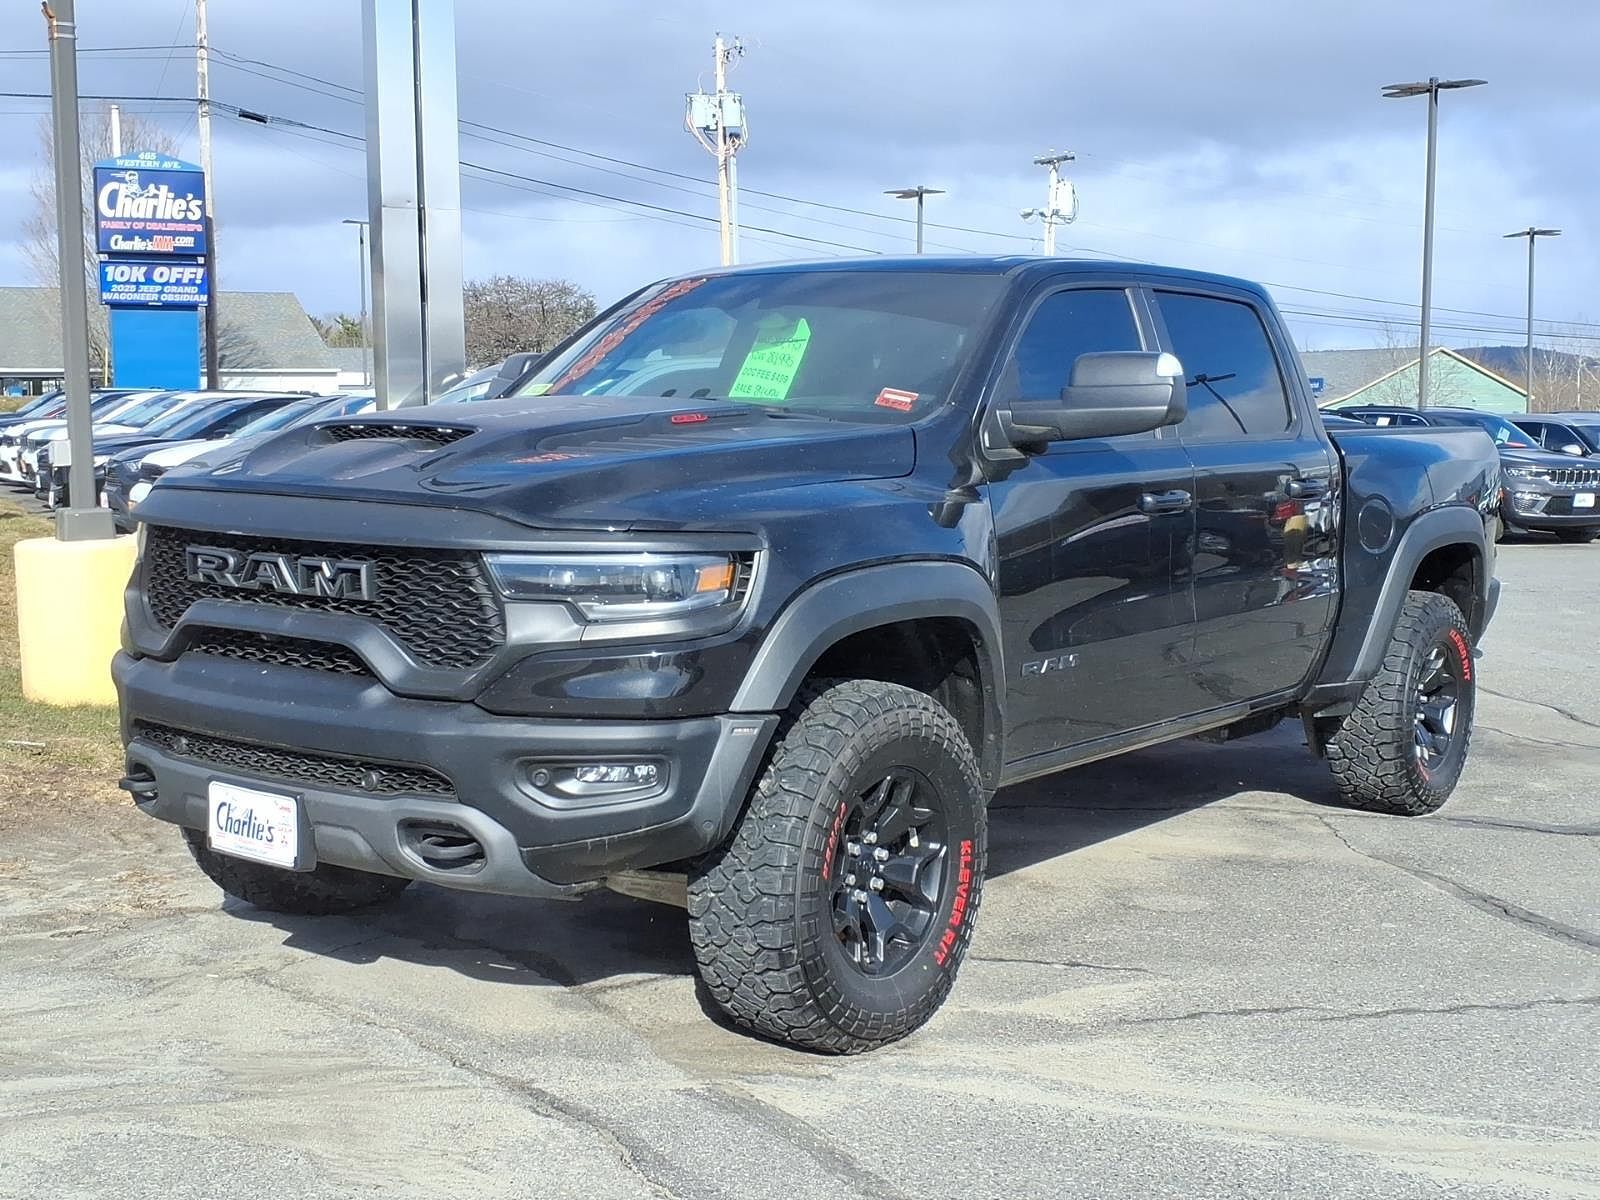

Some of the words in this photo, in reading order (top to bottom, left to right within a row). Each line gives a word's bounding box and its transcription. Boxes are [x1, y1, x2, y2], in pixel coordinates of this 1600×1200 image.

[116, 159, 160, 168] WESTERN
[98, 182, 203, 221] Charlie's
[101, 221, 130, 230] FAMILY
[132, 221, 145, 230] OF
[104, 265, 148, 283] 10K
[152, 266, 205, 284] OFF!
[110, 284, 137, 293] 2025
[138, 285, 163, 293] JEEP
[163, 285, 199, 294] GRAND
[102, 292, 159, 301] WAGONEER
[160, 293, 208, 302] OBSIDIAN
[186, 544, 377, 600] RAM
[216, 801, 276, 843] Charlie's
[950, 839, 973, 927] KLEVER
[933, 927, 957, 967] R/T
